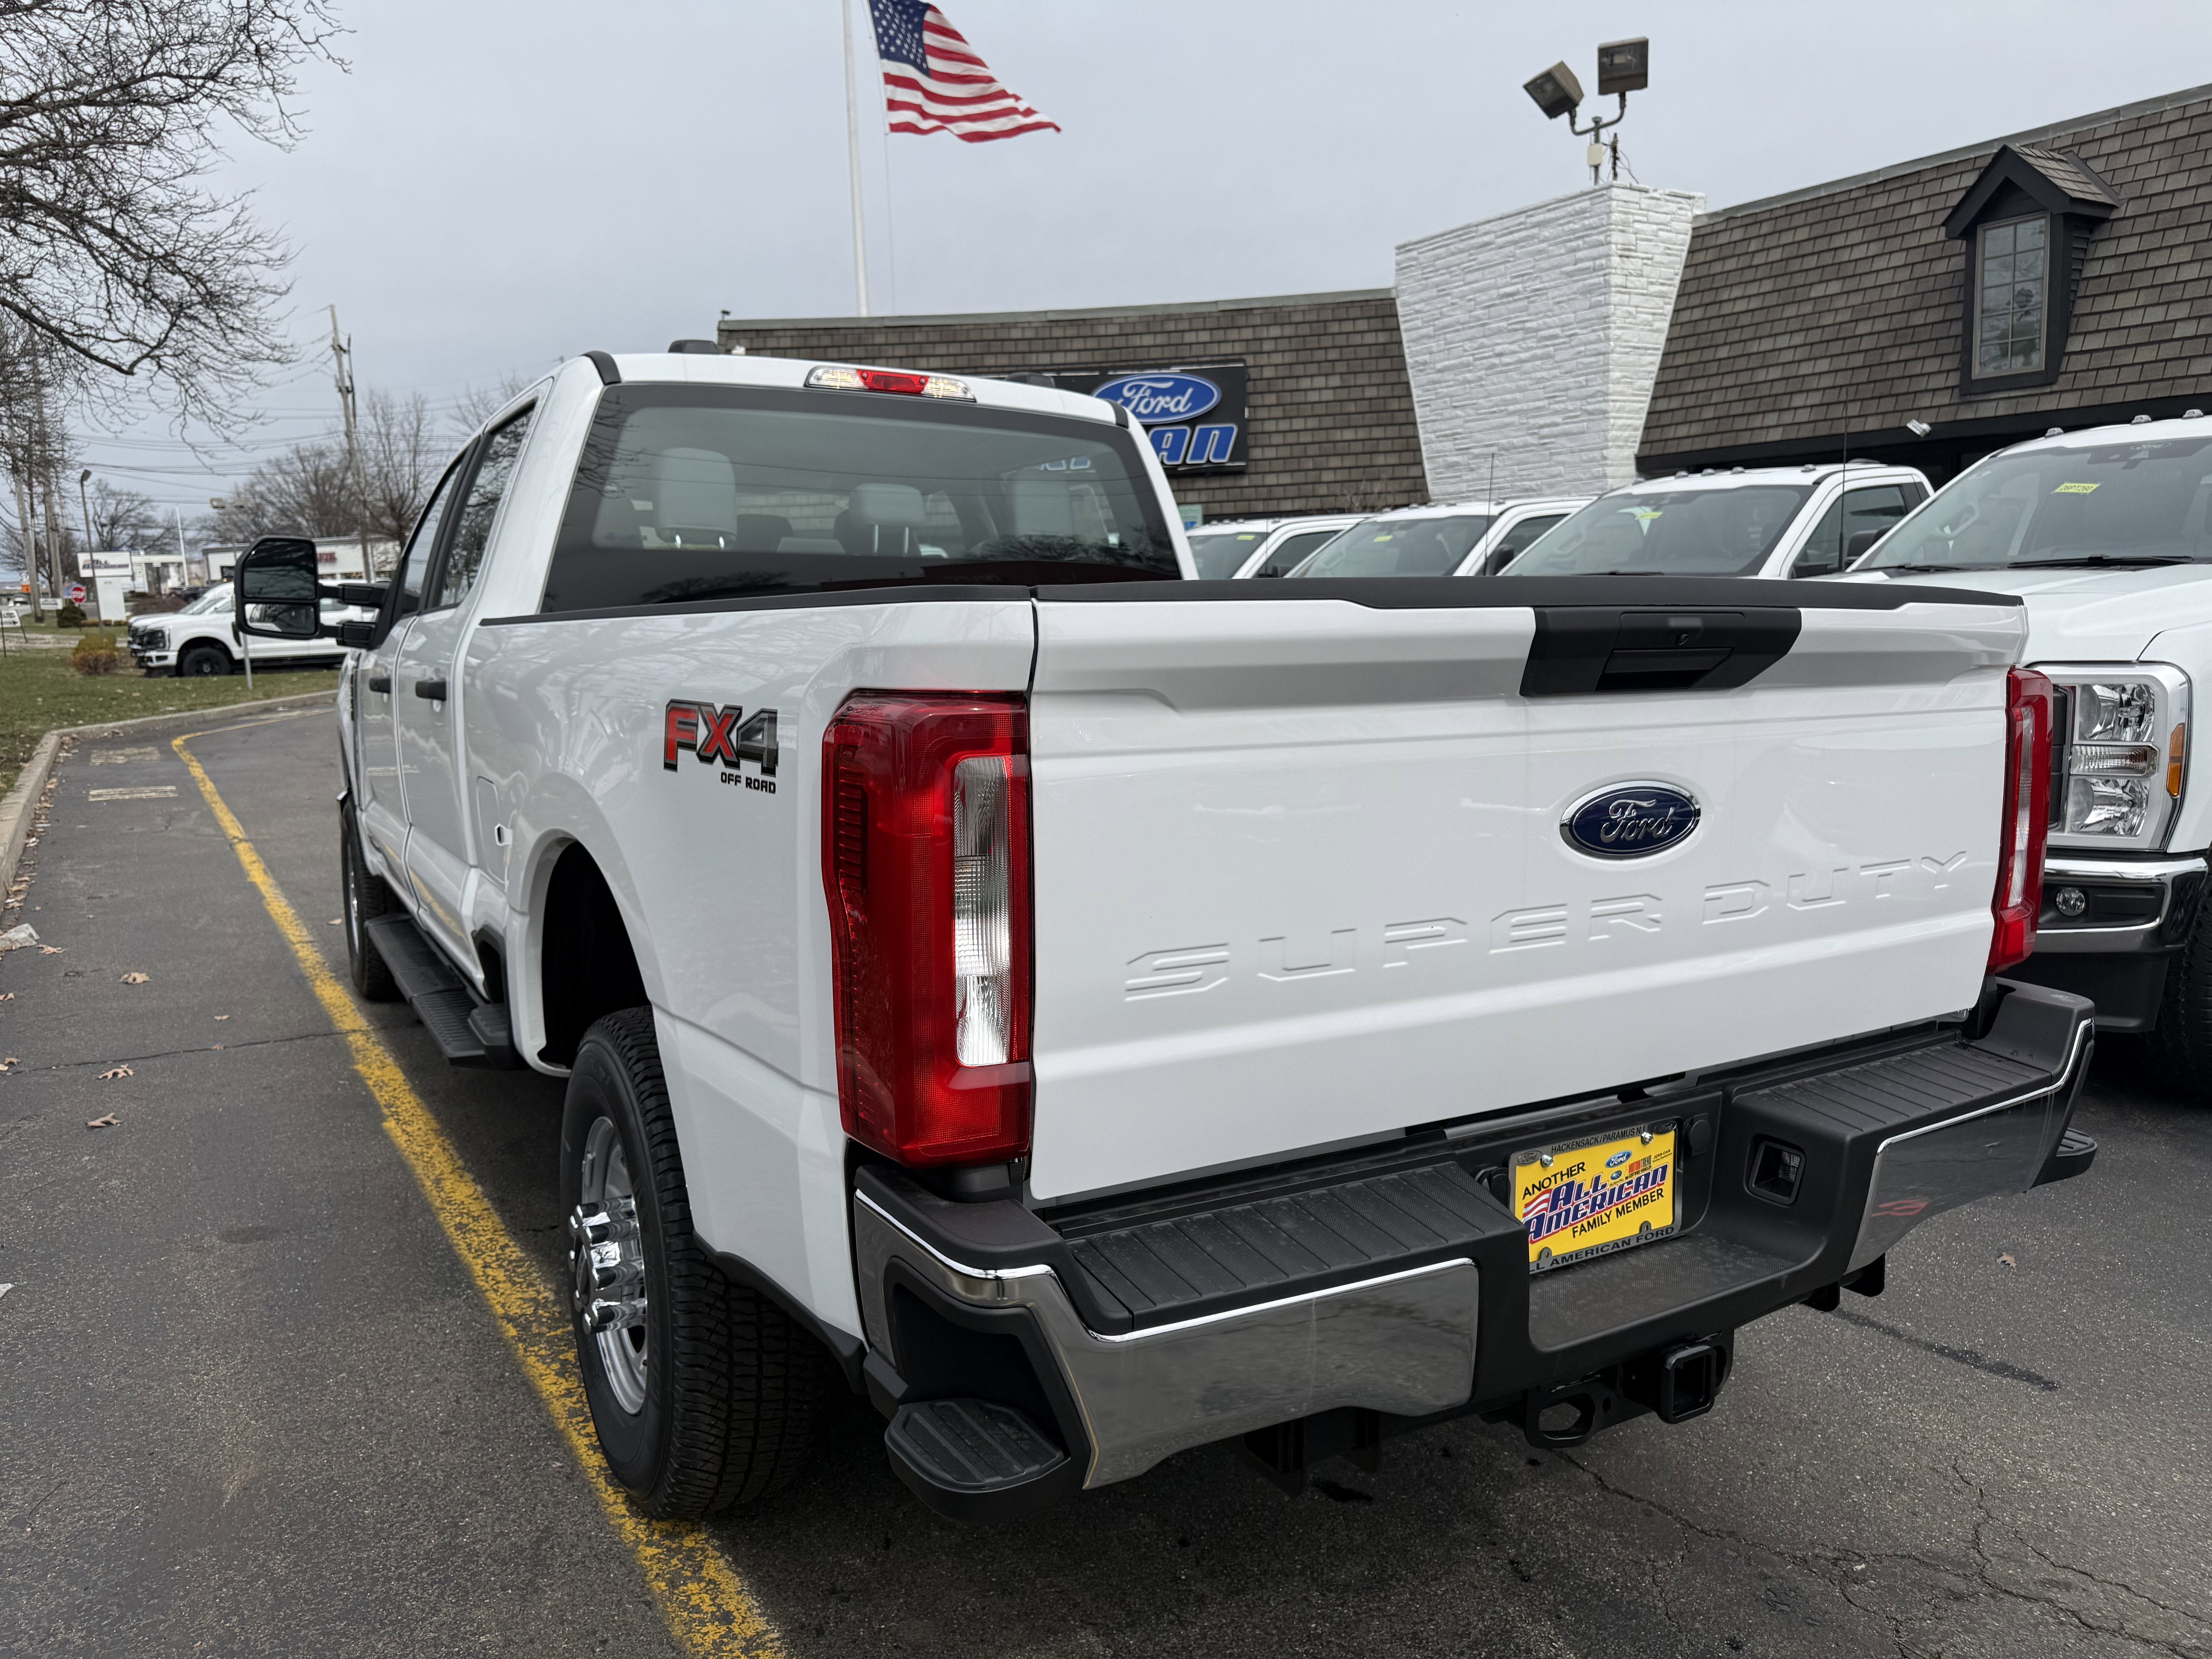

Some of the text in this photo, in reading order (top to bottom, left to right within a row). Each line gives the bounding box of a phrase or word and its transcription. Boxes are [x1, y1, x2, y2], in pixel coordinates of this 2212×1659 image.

[1116, 380, 1194, 414] Ford
[664, 699, 778, 778] FX4
[721, 771, 776, 794] OFF ROAD
[1600, 799, 1675, 843] Ford
[1124, 850, 1967, 1001] SUPER DUTY
[1522, 1152, 1537, 1162] Ford
[1551, 1127, 1635, 1154] HACKENSACK/PARAMUS
[1610, 1153, 1627, 1166] Ford
[1523, 1162, 1586, 1200] ANOTHER
[1547, 1173, 1609, 1214] ALL
[1523, 1163, 1669, 1242] AMERICAN
[1572, 1188, 1664, 1238] FAMILY MEMBER
[1550, 1238, 1630, 1267] AMERICAN
[1636, 1227, 1674, 1243] FORD
